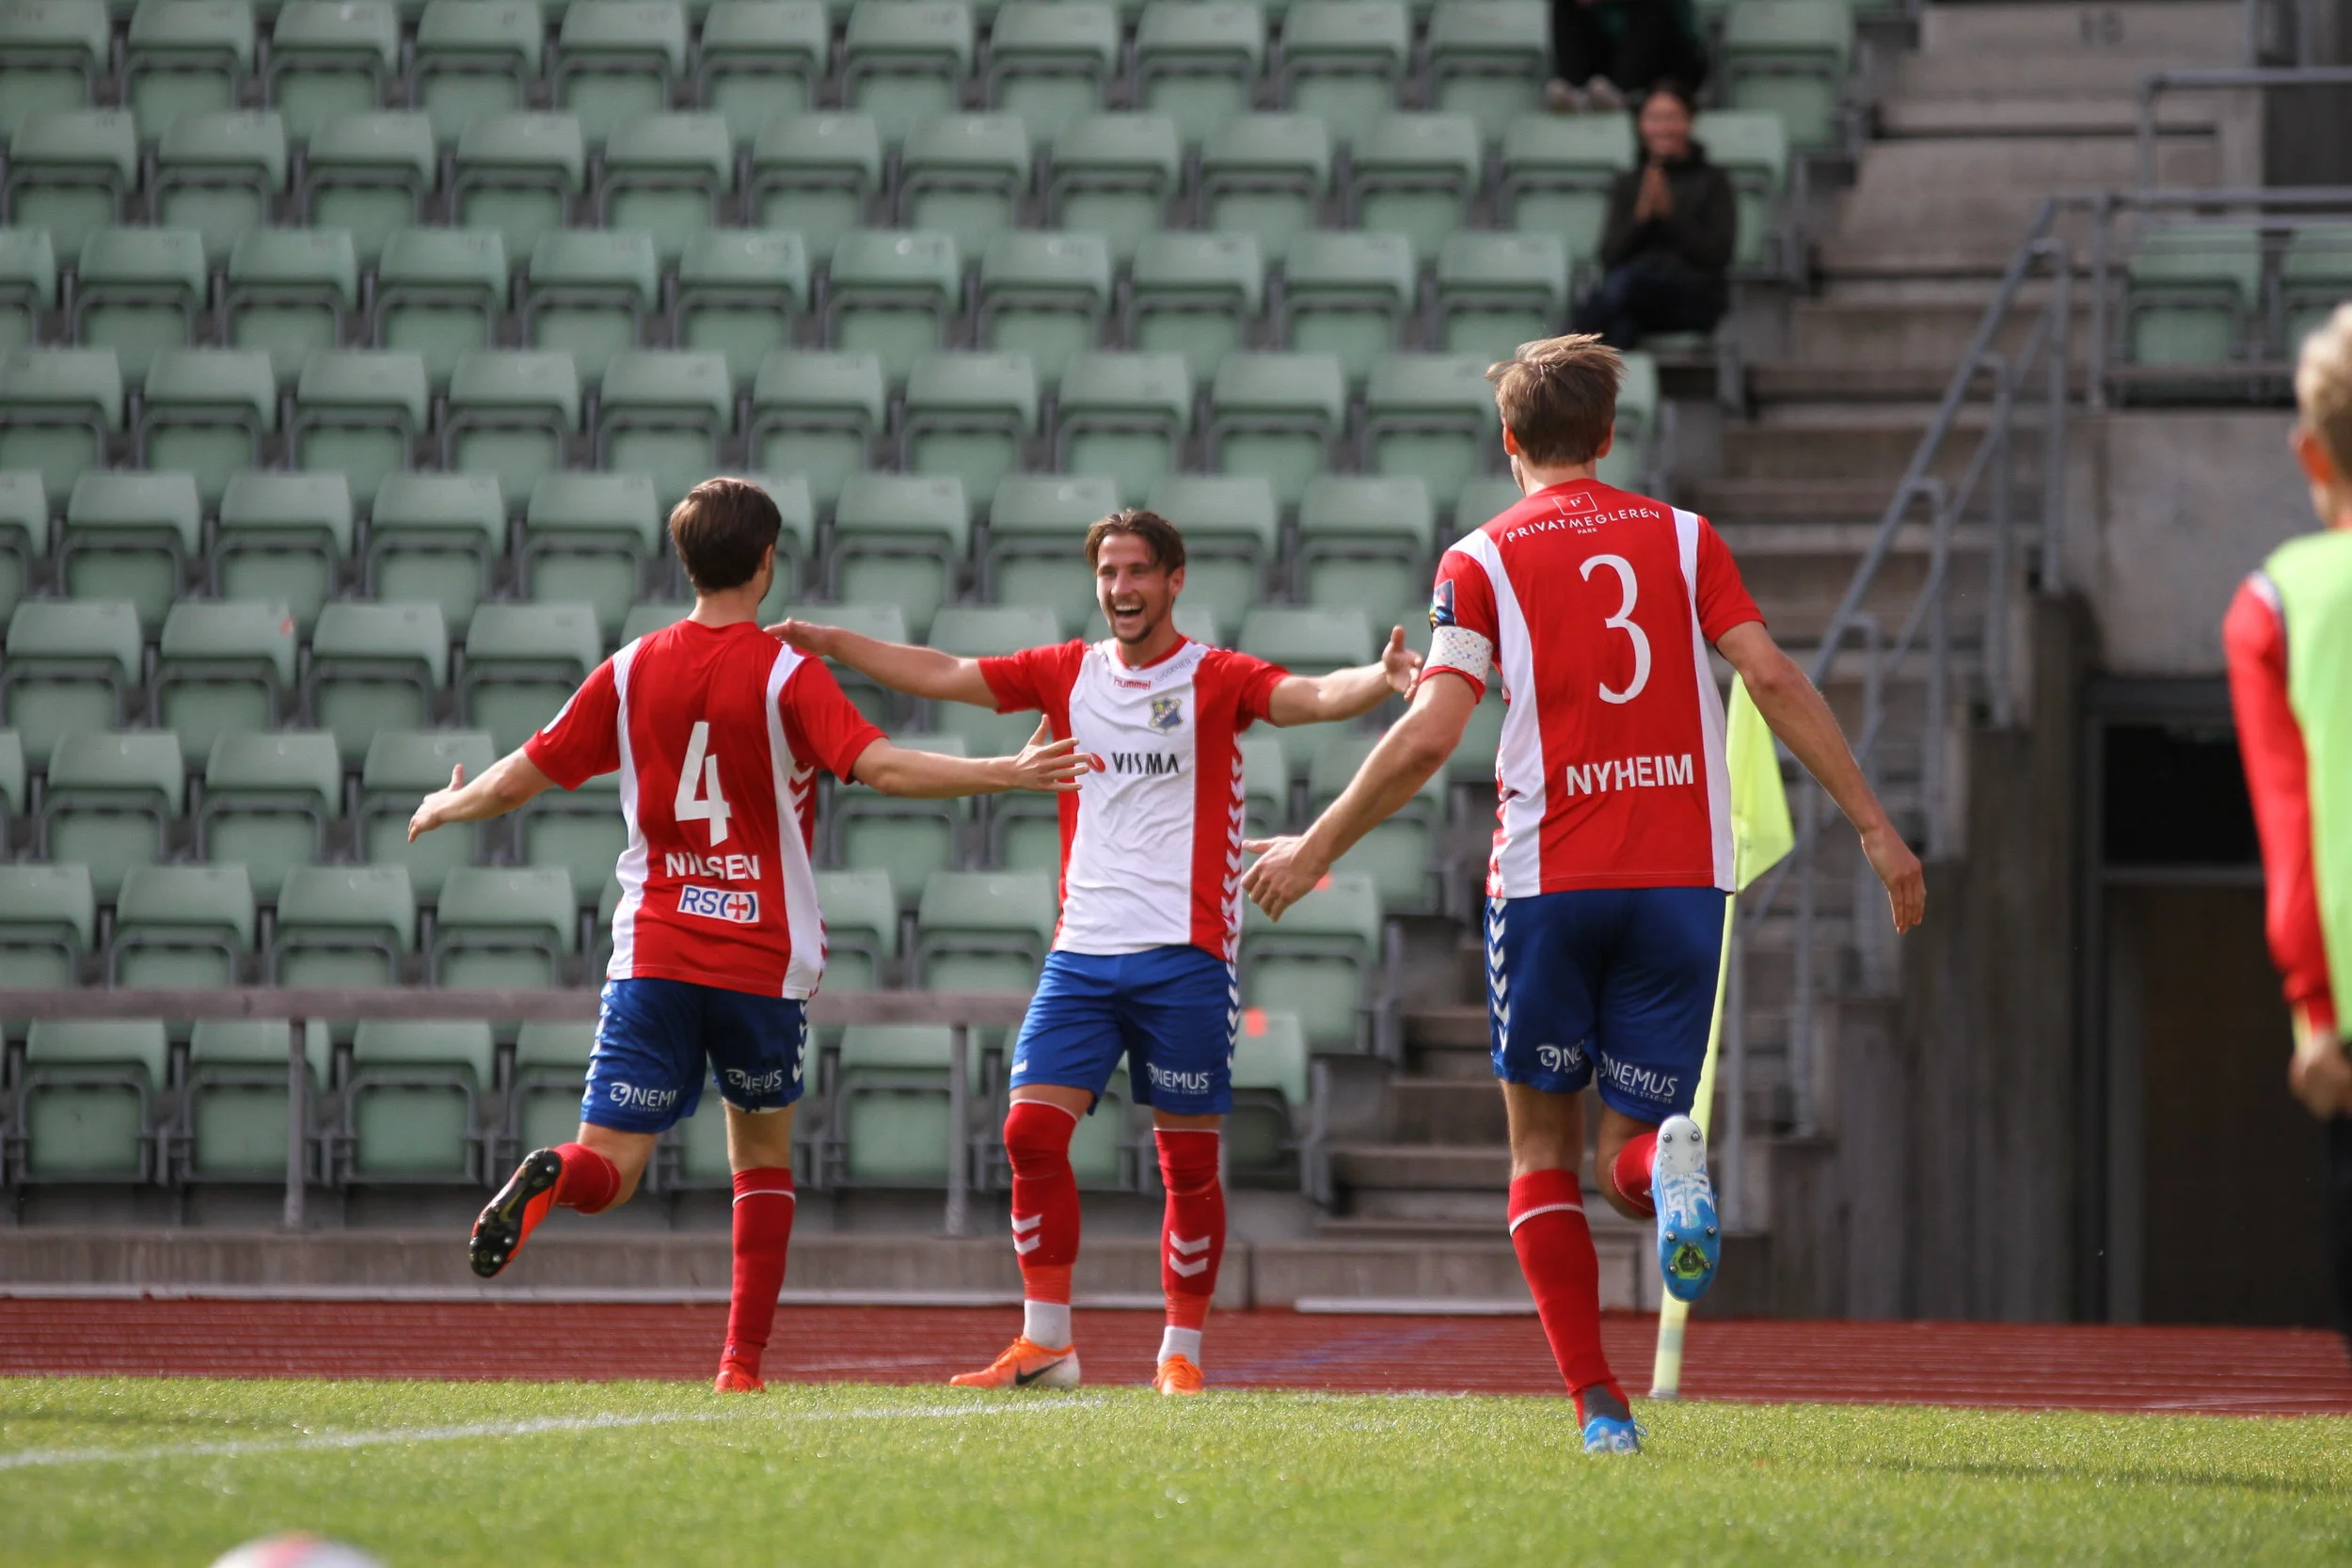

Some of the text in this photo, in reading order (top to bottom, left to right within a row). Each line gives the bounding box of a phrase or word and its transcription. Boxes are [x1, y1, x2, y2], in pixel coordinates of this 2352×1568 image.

[1505, 508, 1661, 543] PRIVATMEGLEREN
[1579, 553, 1652, 705] 3
[1114, 676, 1152, 691] hummel
[1111, 752, 1180, 775] VISMA
[1565, 753, 1694, 797] NYHEIM
[674, 721, 732, 847] 4
[664, 852, 761, 880] NILSEN
